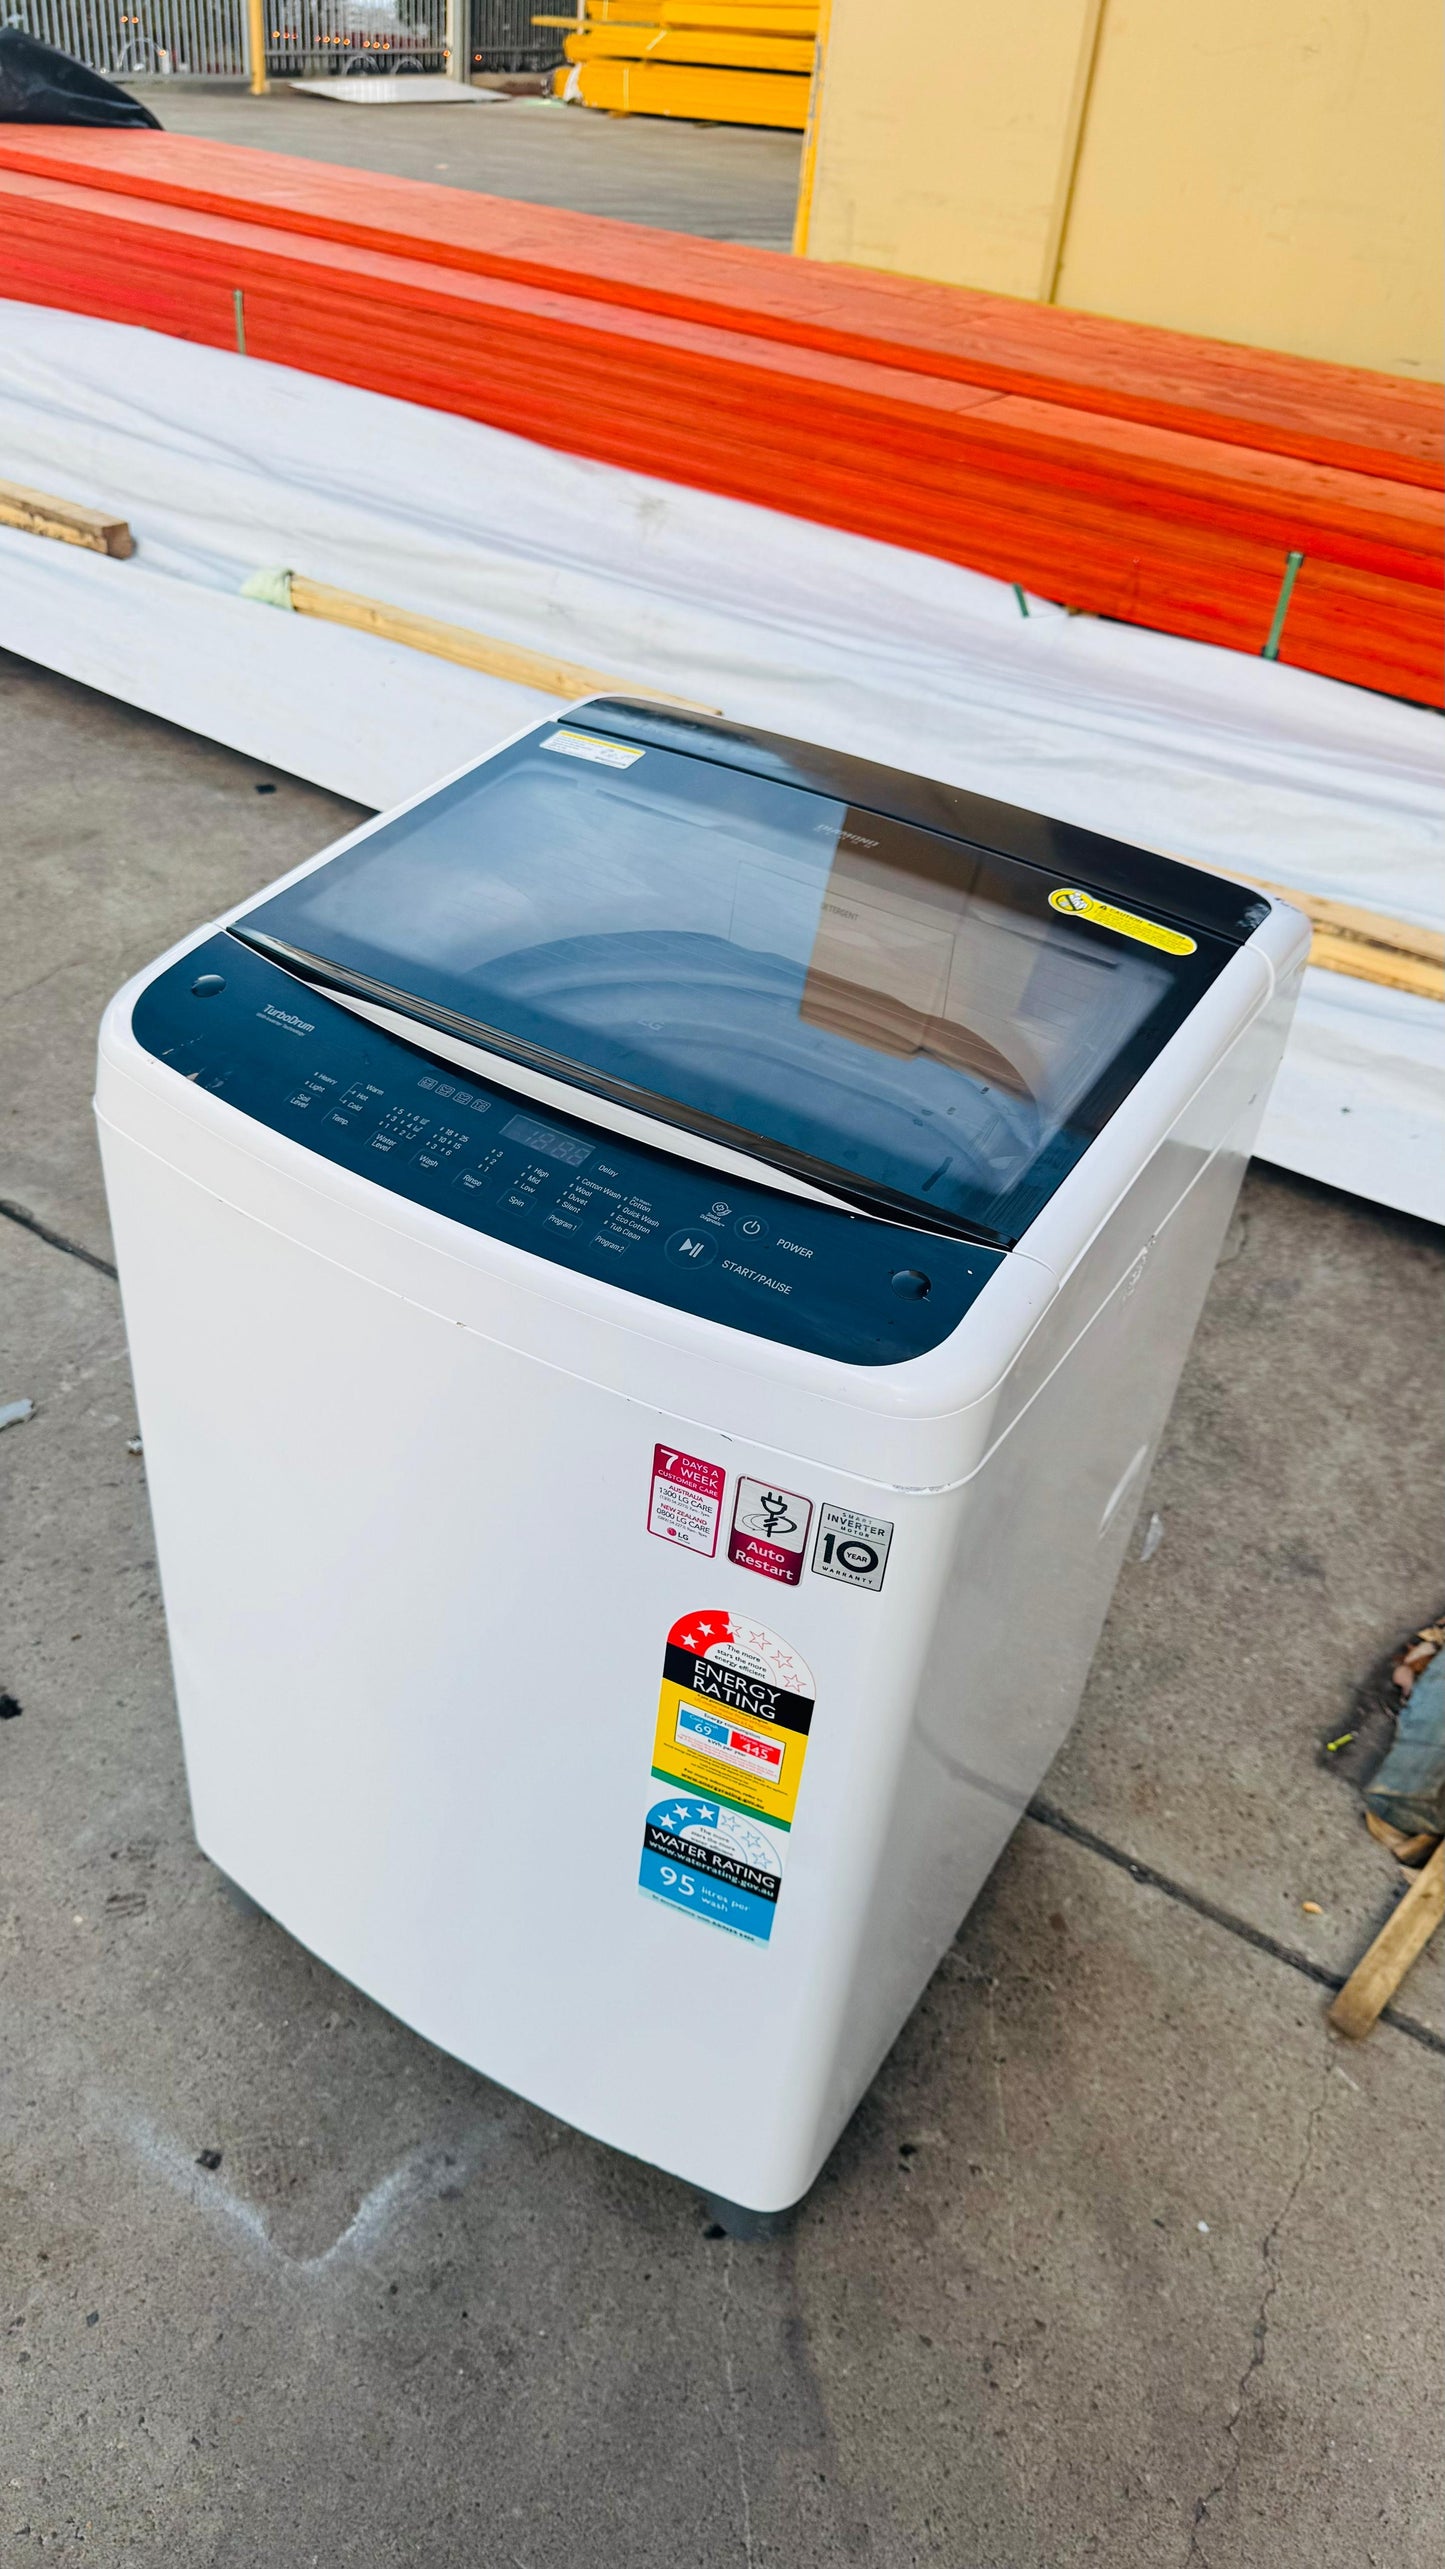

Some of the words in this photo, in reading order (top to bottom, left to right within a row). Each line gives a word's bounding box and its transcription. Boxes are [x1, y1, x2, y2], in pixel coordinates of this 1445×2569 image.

[263, 1003, 315, 1032] TurboDrum
[308, 1082, 325, 1093] Light
[318, 1073, 338, 1086] Heavy
[297, 1093, 311, 1102] Soil
[356, 1092, 369, 1101] Hot
[366, 1083, 385, 1096] Warm
[290, 1097, 309, 1109] Level
[347, 1102, 363, 1112] Cold
[376, 1133, 398, 1146] Water
[438, 1136, 447, 1144] 10
[452, 1142, 462, 1150] 15
[445, 1128, 454, 1136] 18
[459, 1134, 470, 1142] 25
[371, 1140, 391, 1152] Level
[419, 1154, 439, 1167] Wash
[527, 1174, 542, 1185] Mid
[533, 1167, 550, 1178] High
[598, 1164, 619, 1178] Delay
[462, 1174, 482, 1187] Rinse
[520, 1183, 536, 1193] Low
[581, 1178, 603, 1192] Cotton
[602, 1187, 622, 1200] Wash
[568, 1193, 588, 1206] Duvet
[575, 1185, 593, 1197] Wool
[508, 1195, 525, 1208] Spin
[561, 1201, 581, 1214] Silent
[629, 1199, 651, 1213] Cotton
[548, 1214, 573, 1230] Program
[615, 1214, 629, 1225] Eco
[628, 1220, 651, 1234] Cotton
[622, 1206, 641, 1219] Quick
[641, 1214, 660, 1227] Wash
[610, 1222, 623, 1233] Tub
[622, 1228, 641, 1241] Clean
[776, 1238, 814, 1259] POWER
[721, 1259, 793, 1295] START/PAUSE
[660, 1449, 679, 1471] 7
[682, 1458, 709, 1474] DAYS
[711, 1470, 719, 1478] A
[658, 1469, 698, 1489] CUSTOMER
[699, 1486, 718, 1498] CARE
[681, 1467, 718, 1489] WEEK
[659, 1486, 677, 1499] 1300
[678, 1494, 689, 1504] LG
[690, 1500, 713, 1514] CARE
[668, 1485, 704, 1503] AUSTRALIA
[656, 1507, 675, 1520] 0800
[676, 1515, 687, 1525] LG
[688, 1520, 710, 1535] CARE
[660, 1502, 676, 1513] NEW
[677, 1509, 708, 1526] ZEALAND
[842, 1512, 873, 1525] SMART
[827, 1513, 885, 1537] INVERTER
[841, 1526, 870, 1538] MOTOR
[678, 1532, 689, 1541] LG
[746, 1541, 785, 1563] Auto
[823, 1533, 879, 1573] 10
[846, 1551, 868, 1563] YEAR
[735, 1549, 794, 1581] Restart
[822, 1565, 873, 1585] WARRANTY
[717, 1649, 734, 1660] stars
[734, 1654, 746, 1664] the
[747, 1660, 767, 1672] more
[726, 1644, 740, 1654] The
[741, 1651, 761, 1663] more
[714, 1655, 738, 1669] energy
[738, 1664, 766, 1679] efficient
[694, 1659, 781, 1704] ENERGY
[693, 1675, 776, 1720] RATING
[694, 1723, 712, 1736] 69
[742, 1743, 769, 1760] 445
[651, 1828, 707, 1862] WATER
[712, 1854, 775, 1889] RATING
[649, 1840, 774, 1898] www.waterrating.gov.au
[659, 1866, 695, 1896] 95
[701, 1886, 728, 1903] litres
[731, 1900, 749, 1912] per
[701, 1896, 728, 1912] wash
